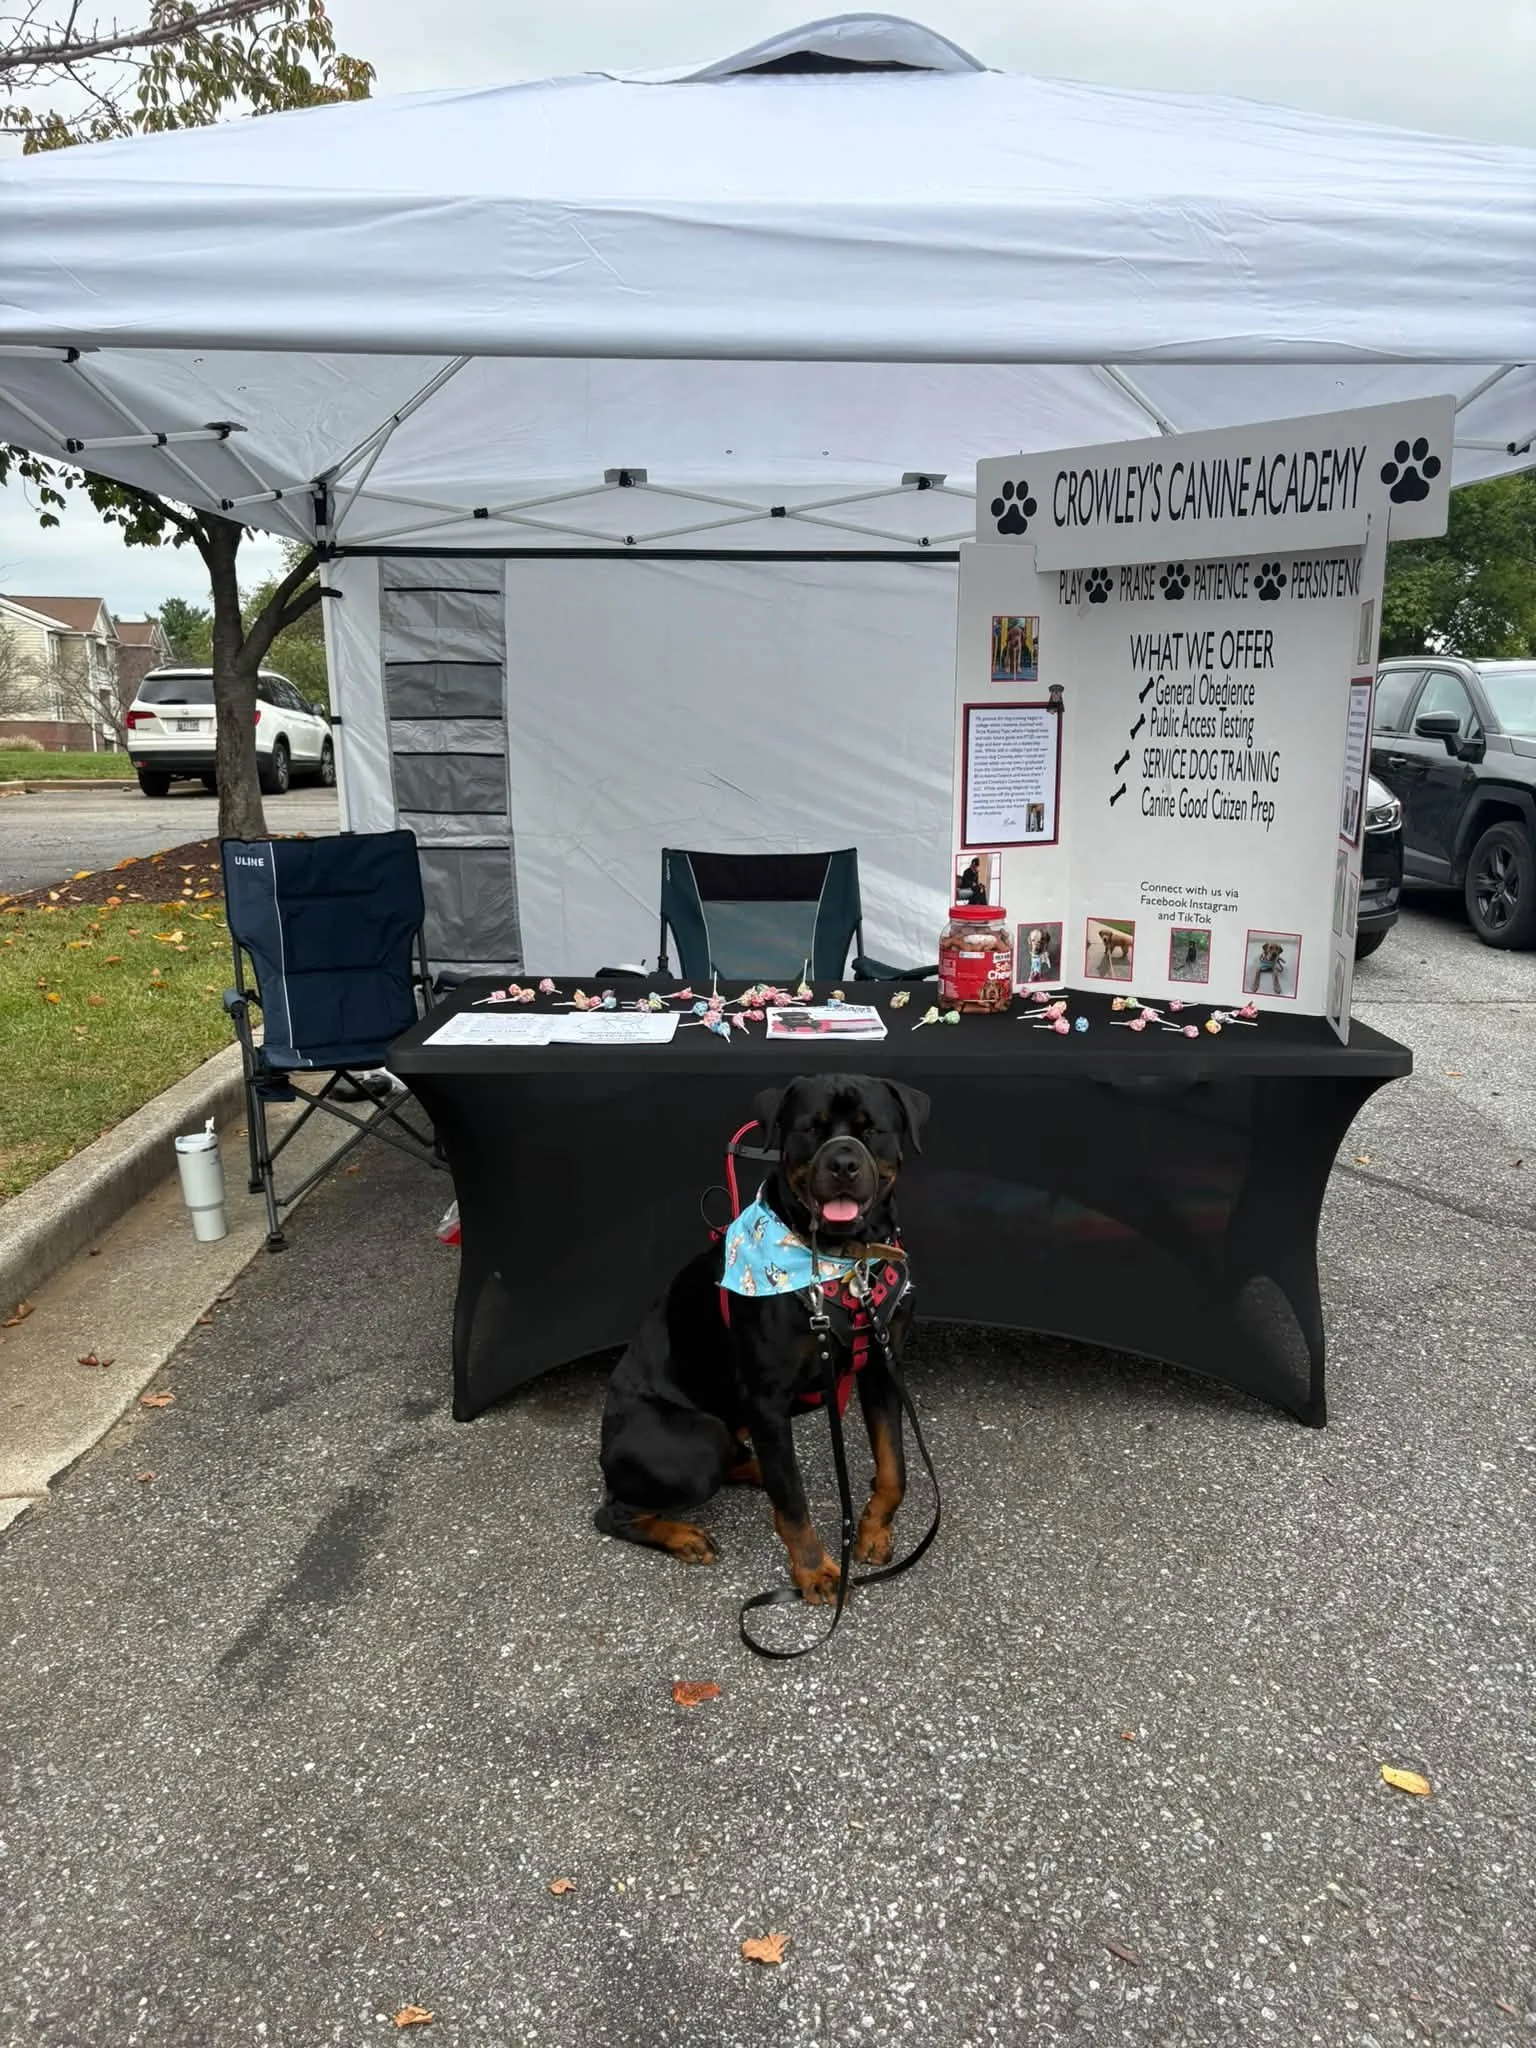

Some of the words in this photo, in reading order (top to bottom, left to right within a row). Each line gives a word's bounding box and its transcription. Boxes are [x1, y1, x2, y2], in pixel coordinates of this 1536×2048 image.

[1053, 461, 1163, 527] CROWLEY'S
[1168, 457, 1251, 521] CANINE
[1251, 445, 1367, 516] ACADEMY
[1059, 569, 1083, 605] PLAY
[1120, 564, 1156, 601] PRAISE
[1193, 561, 1250, 601] PATIENCE
[1130, 632, 1184, 672] WHAT
[1186, 631, 1215, 670] WE
[1220, 629, 1274, 670] OFFER
[1155, 673, 1196, 706] General
[1199, 673, 1255, 706] Obedience
[1150, 706, 1180, 738] Public
[1181, 706, 1216, 738] Access
[1219, 706, 1255, 748] Testing
[1142, 747, 1187, 780] SERVICE
[1188, 748, 1218, 781] DOG
[1221, 749, 1281, 783] TRAINING
[1141, 785, 1175, 818] Canine
[1178, 787, 1209, 819] Good
[1212, 788, 1248, 821] Citizen
[1250, 789, 1275, 833] Prep
[234, 855, 265, 868] ULINE
[1140, 881, 1183, 894] Connect
[1185, 885, 1208, 896] with
[1211, 888, 1222, 897] us
[1225, 887, 1239, 898] via
[1140, 894, 1187, 908] Facebook
[1189, 899, 1238, 913] Instagram
[1157, 911, 1176, 921] and
[1178, 911, 1212, 925] TikTok
